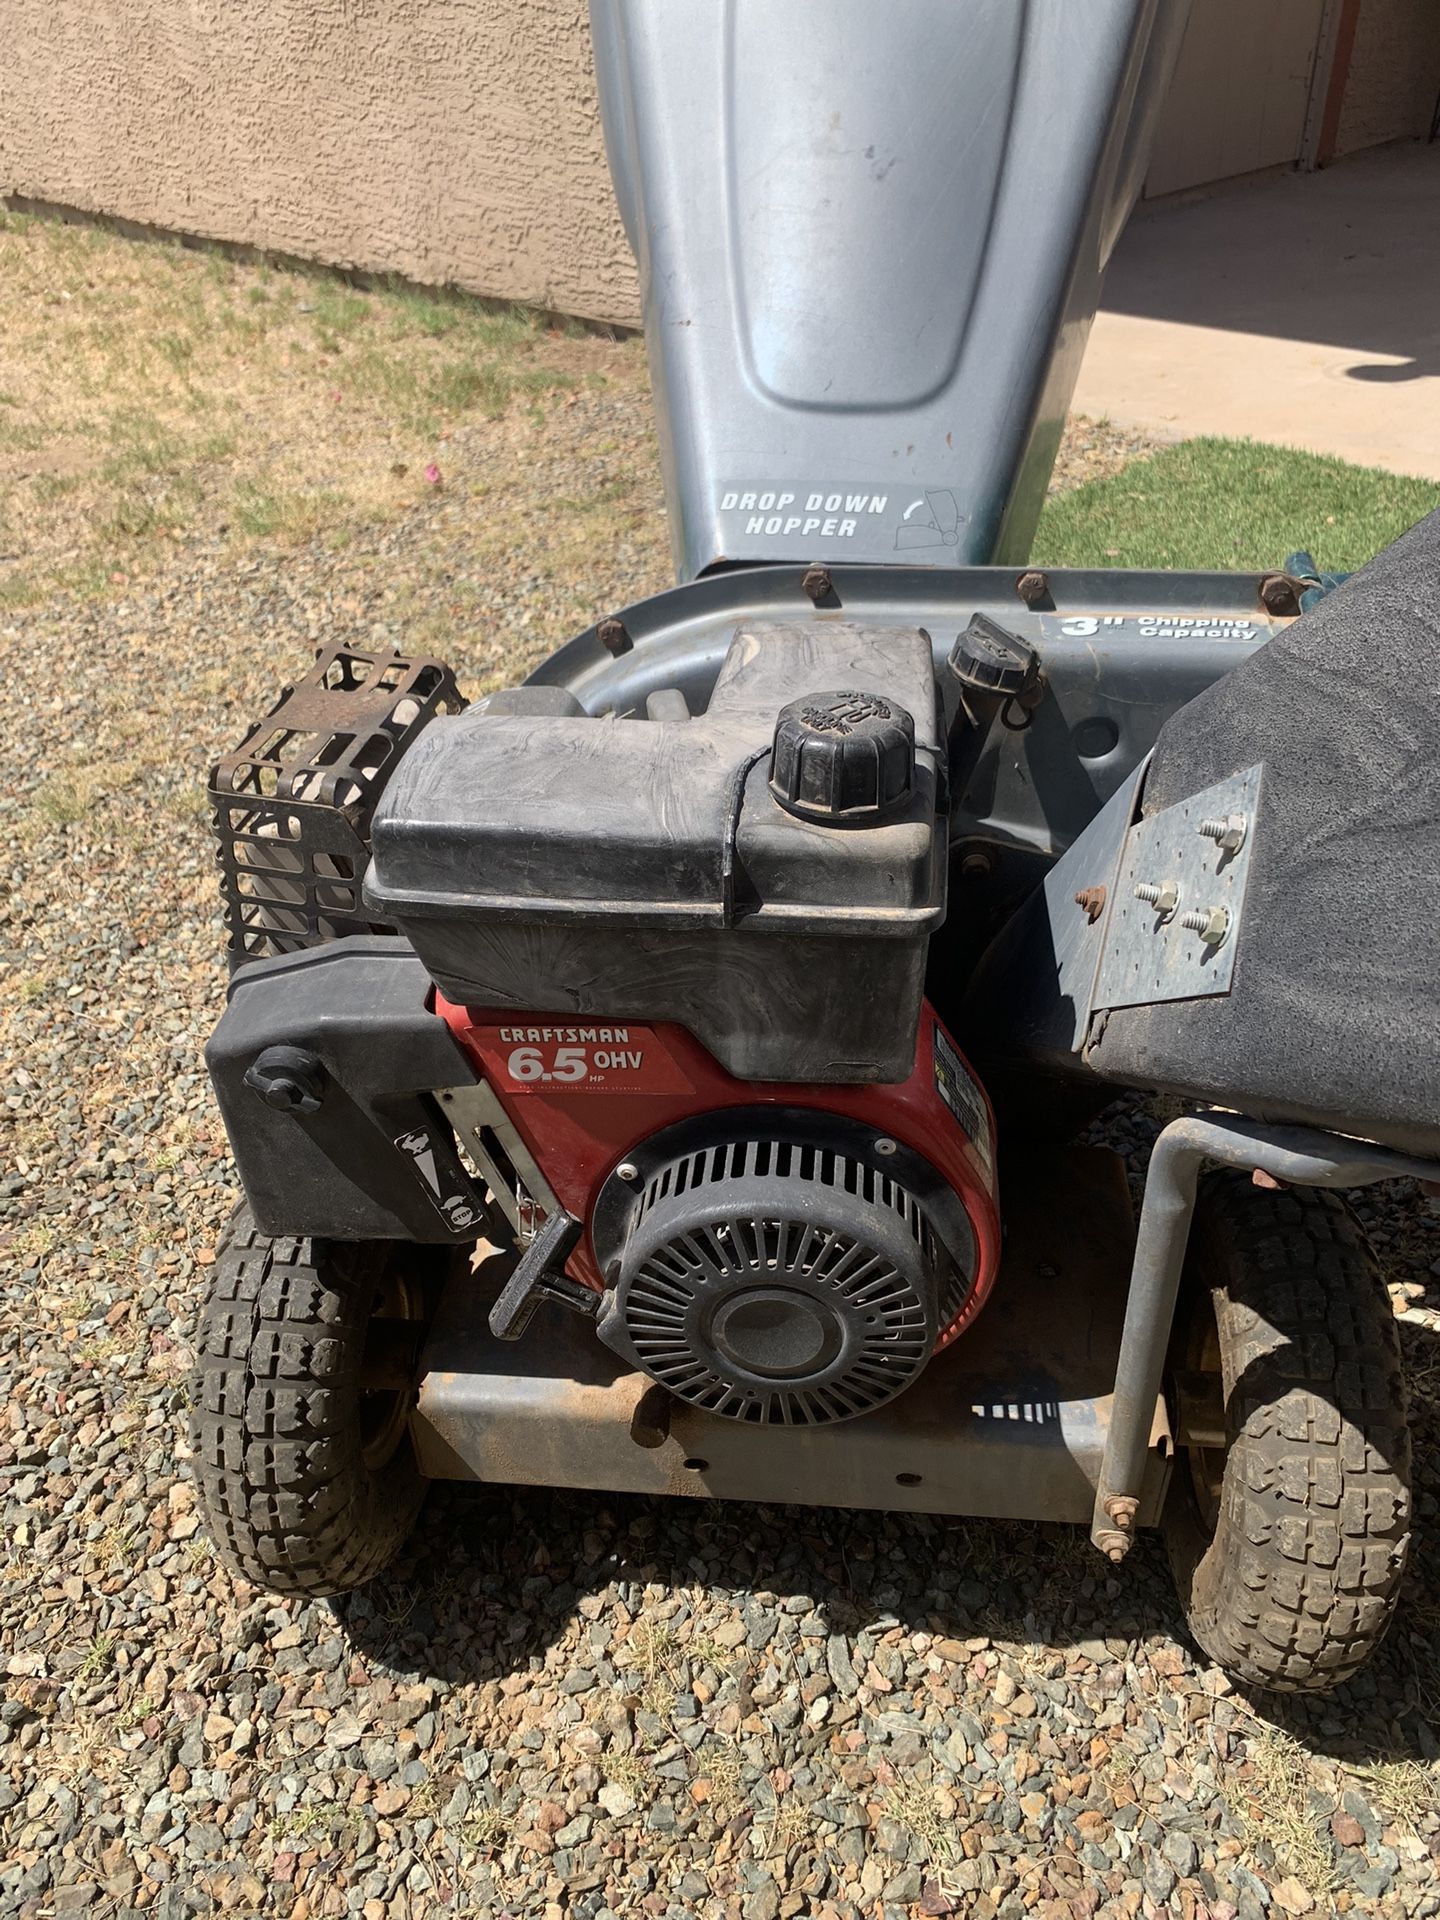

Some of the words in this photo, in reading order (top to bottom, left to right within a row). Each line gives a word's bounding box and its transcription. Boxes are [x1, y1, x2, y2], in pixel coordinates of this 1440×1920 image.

[720, 493, 795, 511] DROP
[804, 495, 888, 514] DOWN
[745, 517, 857, 537] HOPPER
[1137, 616, 1251, 629] Chipping
[1139, 627, 1257, 640] Capacity
[499, 1028, 629, 1043] CRAFTSMAN
[507, 1047, 588, 1082] 6.5
[594, 1051, 643, 1069] OHV
[589, 1074, 605, 1082] HP
[452, 1209, 471, 1222] STOP
